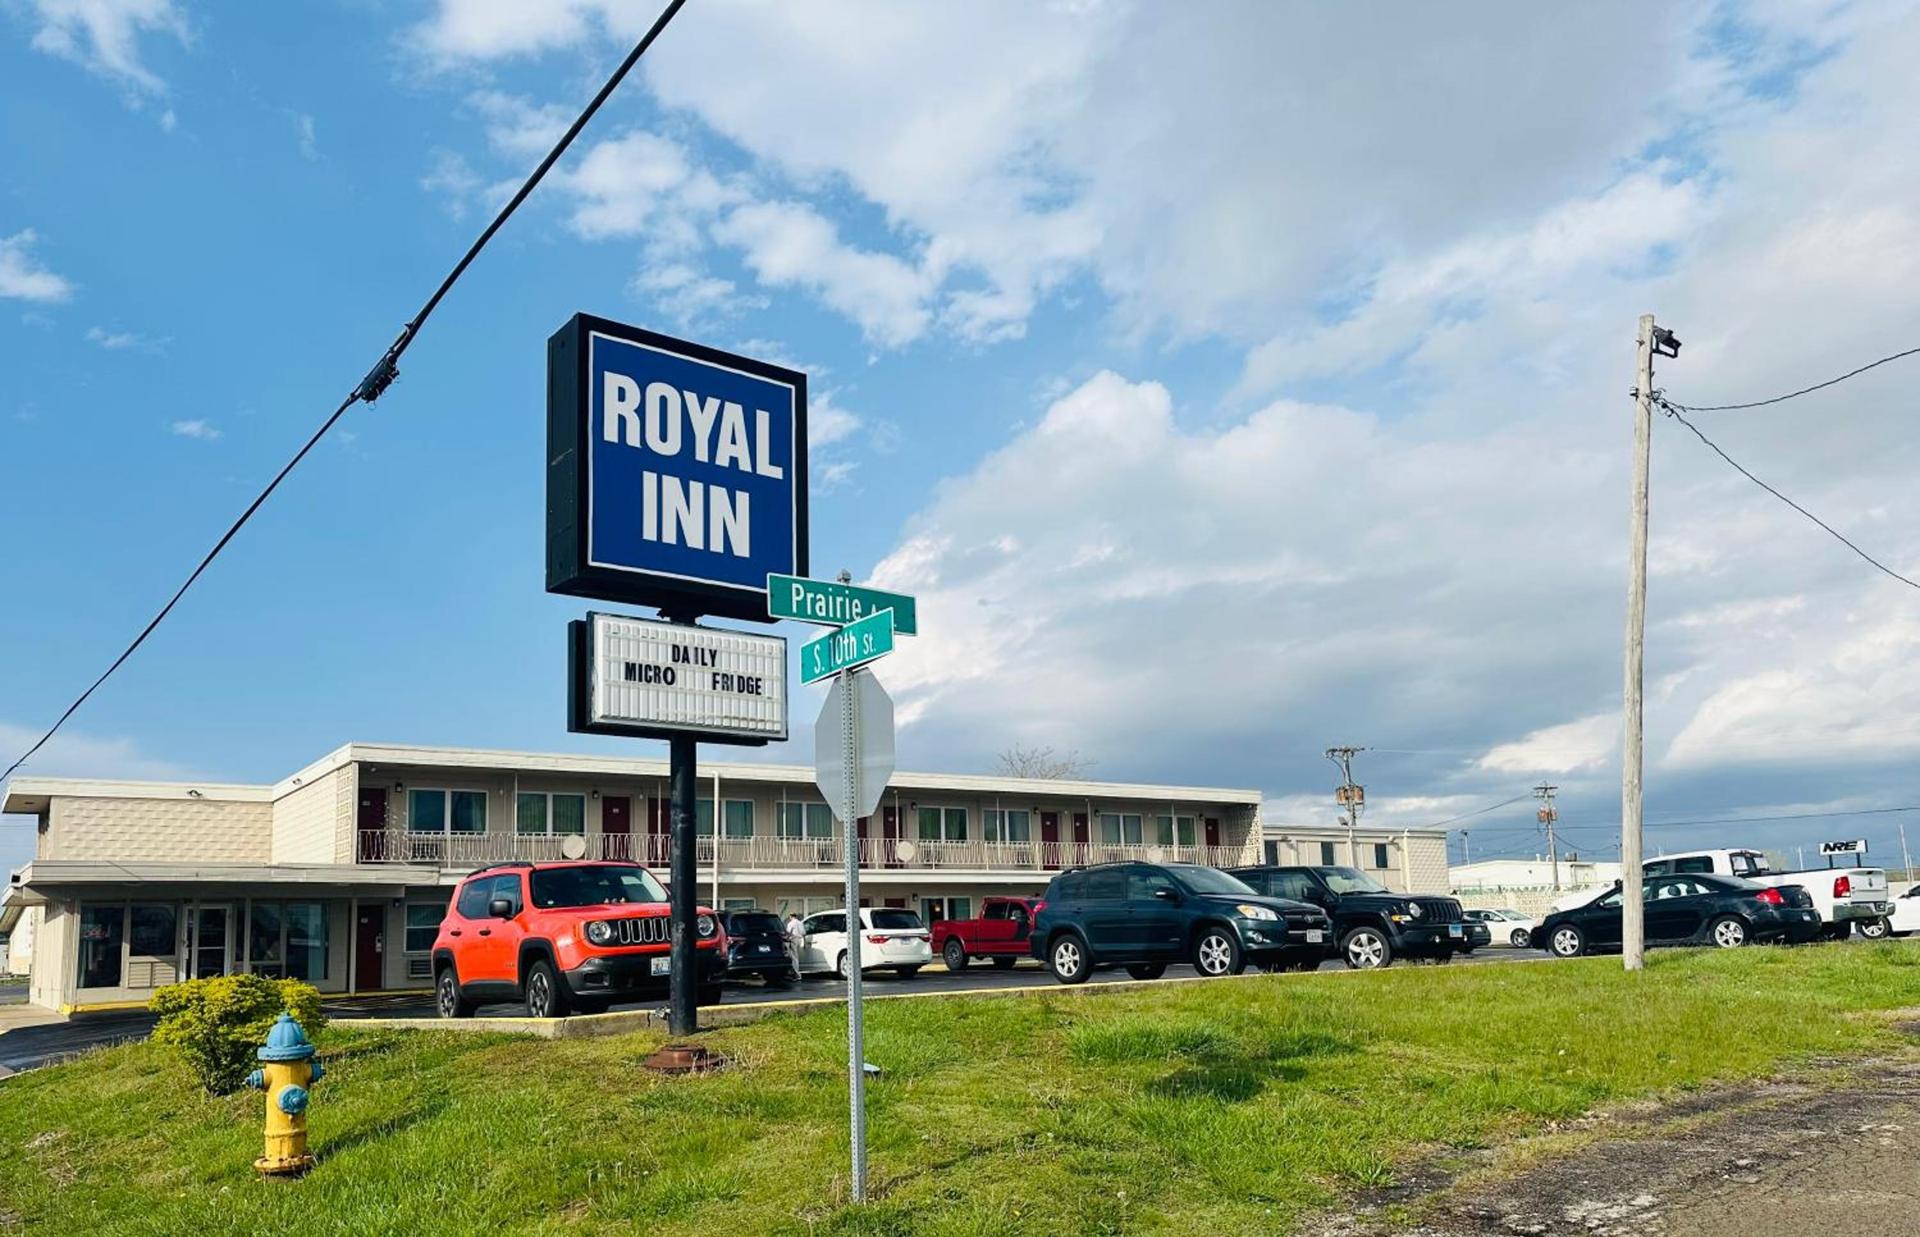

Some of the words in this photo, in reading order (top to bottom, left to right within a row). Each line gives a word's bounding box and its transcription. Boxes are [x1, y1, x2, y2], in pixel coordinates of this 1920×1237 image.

[603, 370, 783, 480] ROYAL
[642, 470, 750, 559] INN
[791, 583, 862, 620] Prairie
[672, 644, 718, 668] DAILY
[813, 644, 825, 674] S.
[829, 630, 857, 667] 10th
[863, 633, 877, 655] St.
[624, 661, 676, 686] MICRO
[712, 672, 762, 696] FRIDGE
